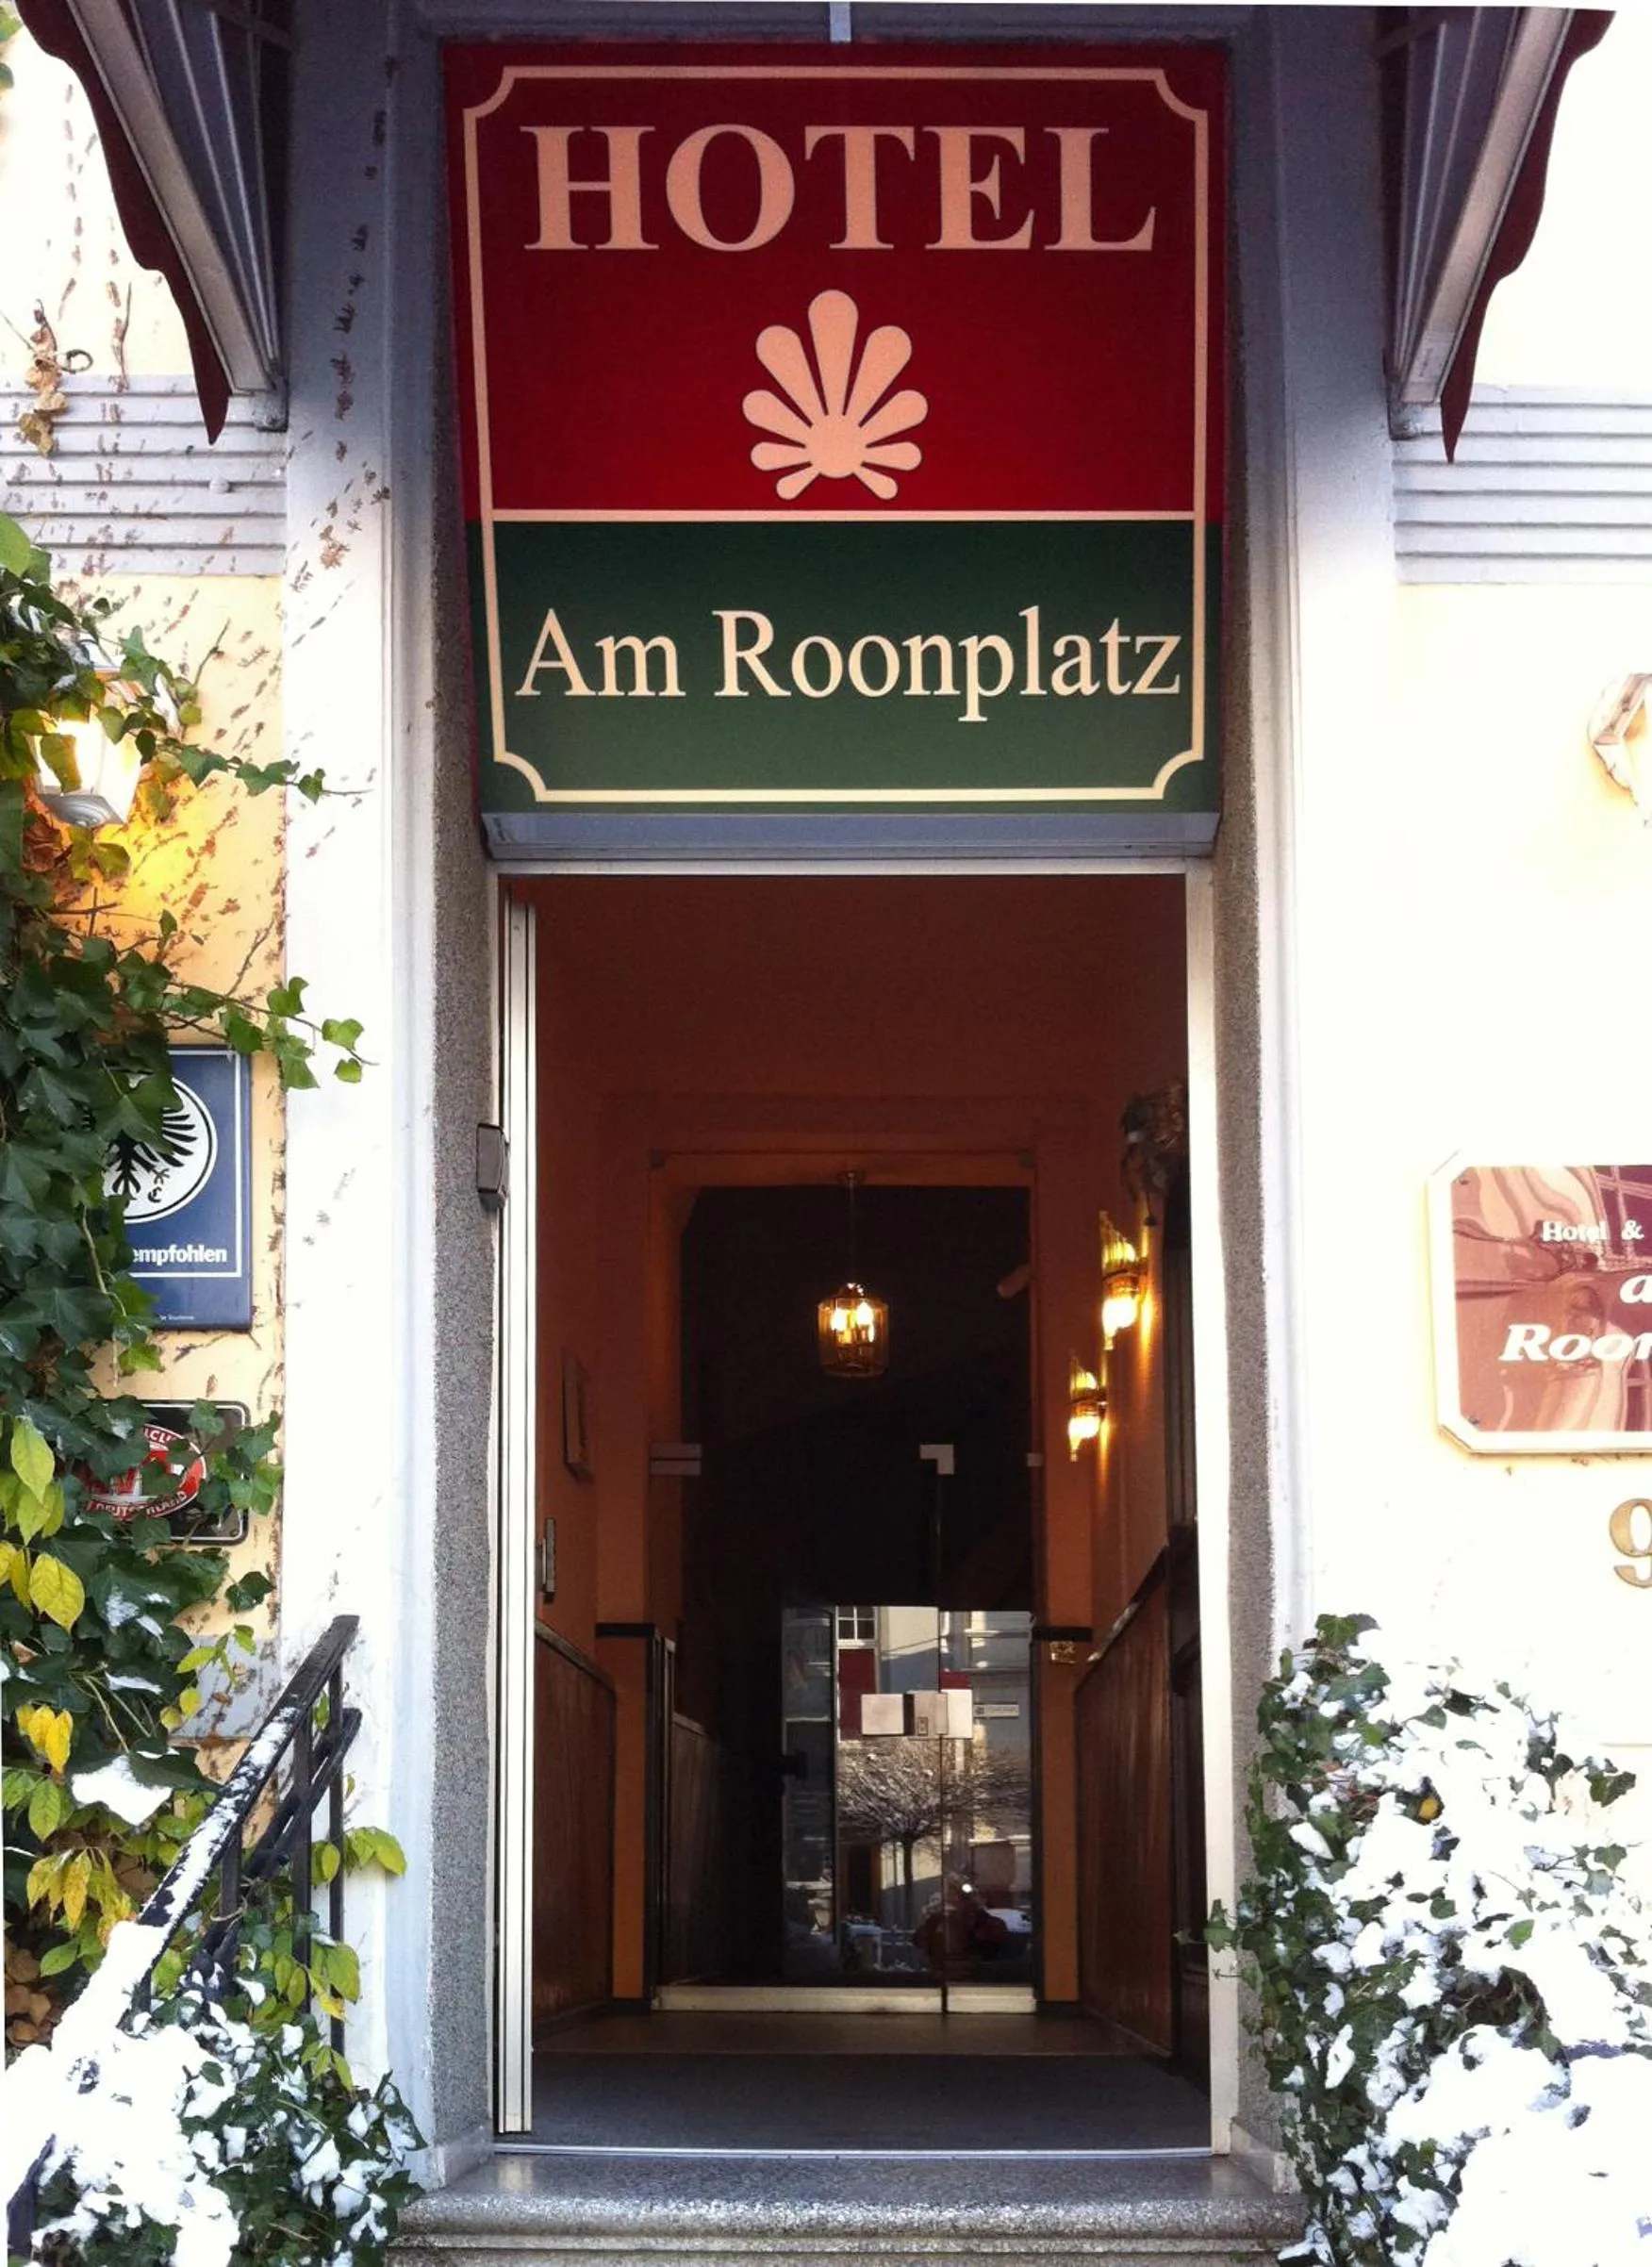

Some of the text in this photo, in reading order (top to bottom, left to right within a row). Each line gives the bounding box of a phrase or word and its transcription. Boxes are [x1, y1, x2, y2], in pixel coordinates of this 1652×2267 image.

[520, 124, 1157, 252] HOTEL
[515, 604, 1181, 722] Am Roonplatz
[1542, 1219, 1644, 1243] Hotel &
[1609, 1498, 1652, 1589] 9
